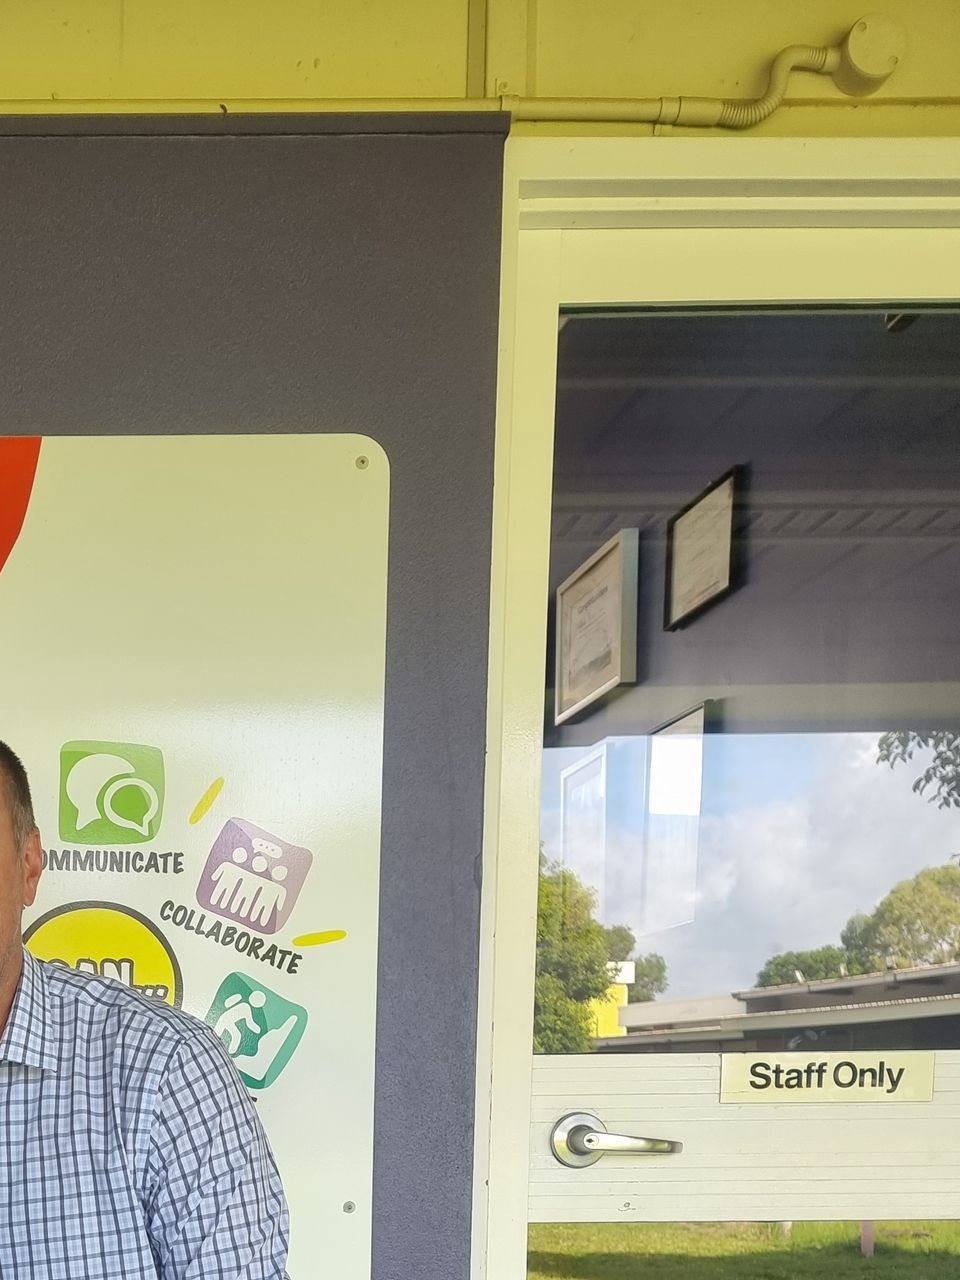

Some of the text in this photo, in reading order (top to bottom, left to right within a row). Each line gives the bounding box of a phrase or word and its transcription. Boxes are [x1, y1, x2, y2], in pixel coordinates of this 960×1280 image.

[160, 900, 303, 975] COLLABORATE
[750, 1061, 905, 1093] Staff Only
